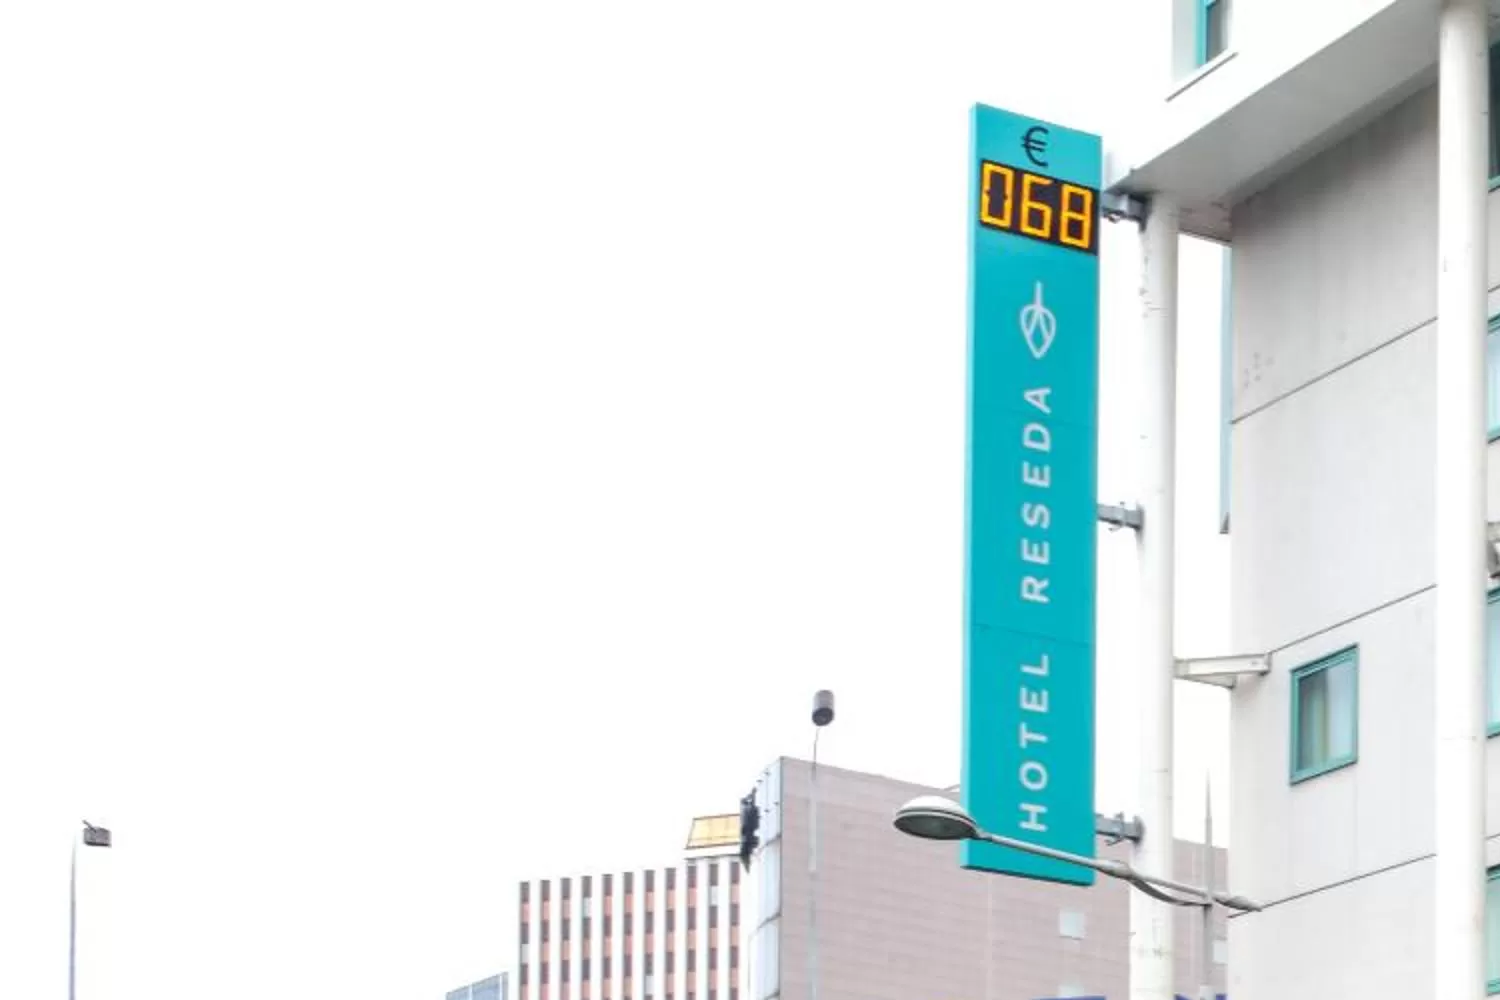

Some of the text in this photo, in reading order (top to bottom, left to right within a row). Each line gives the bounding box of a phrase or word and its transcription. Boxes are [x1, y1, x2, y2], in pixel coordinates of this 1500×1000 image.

[1021, 126, 1049, 167] €
[980, 163, 1094, 249] 068
[1019, 387, 1051, 832] HOTEL RESEDA
